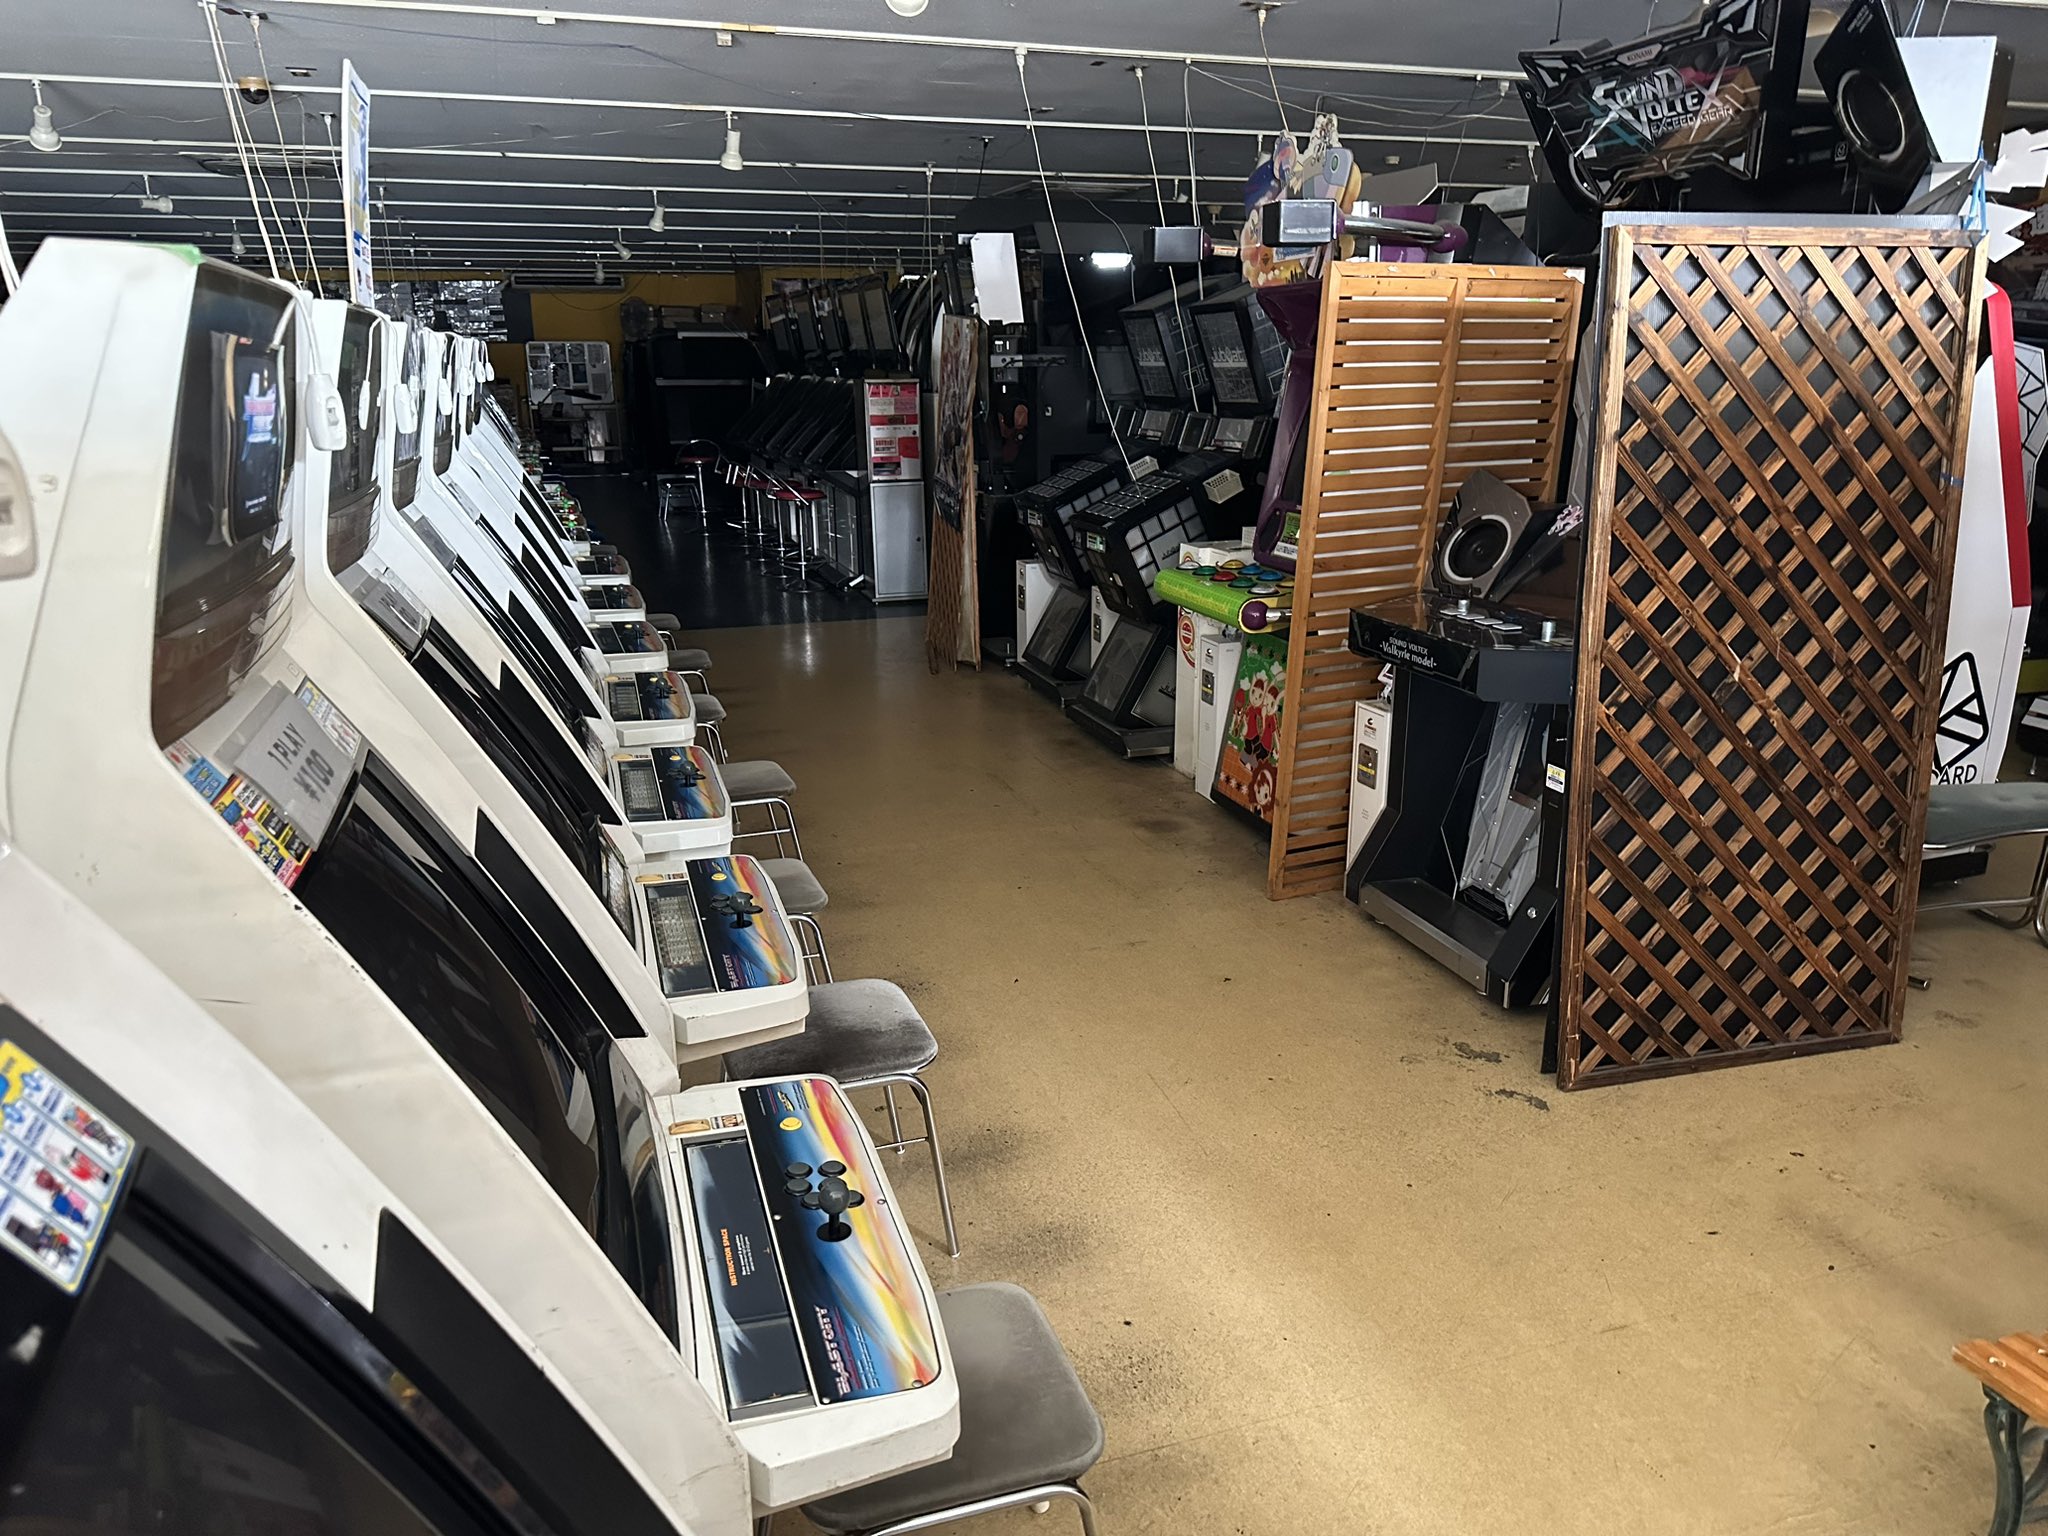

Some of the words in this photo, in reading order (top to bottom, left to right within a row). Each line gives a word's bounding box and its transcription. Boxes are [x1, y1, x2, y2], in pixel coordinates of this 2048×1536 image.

[1592, 66, 1685, 111] SOUND
[1651, 113, 1696, 136] EXCEED
[1701, 105, 1734, 123] GEAR
[1389, 636, 1407, 648] SOUND
[1408, 643, 1428, 655] VOLTEX
[720, 1228, 731, 1247] SPACE
[725, 1247, 738, 1287] INSTRUCTION
